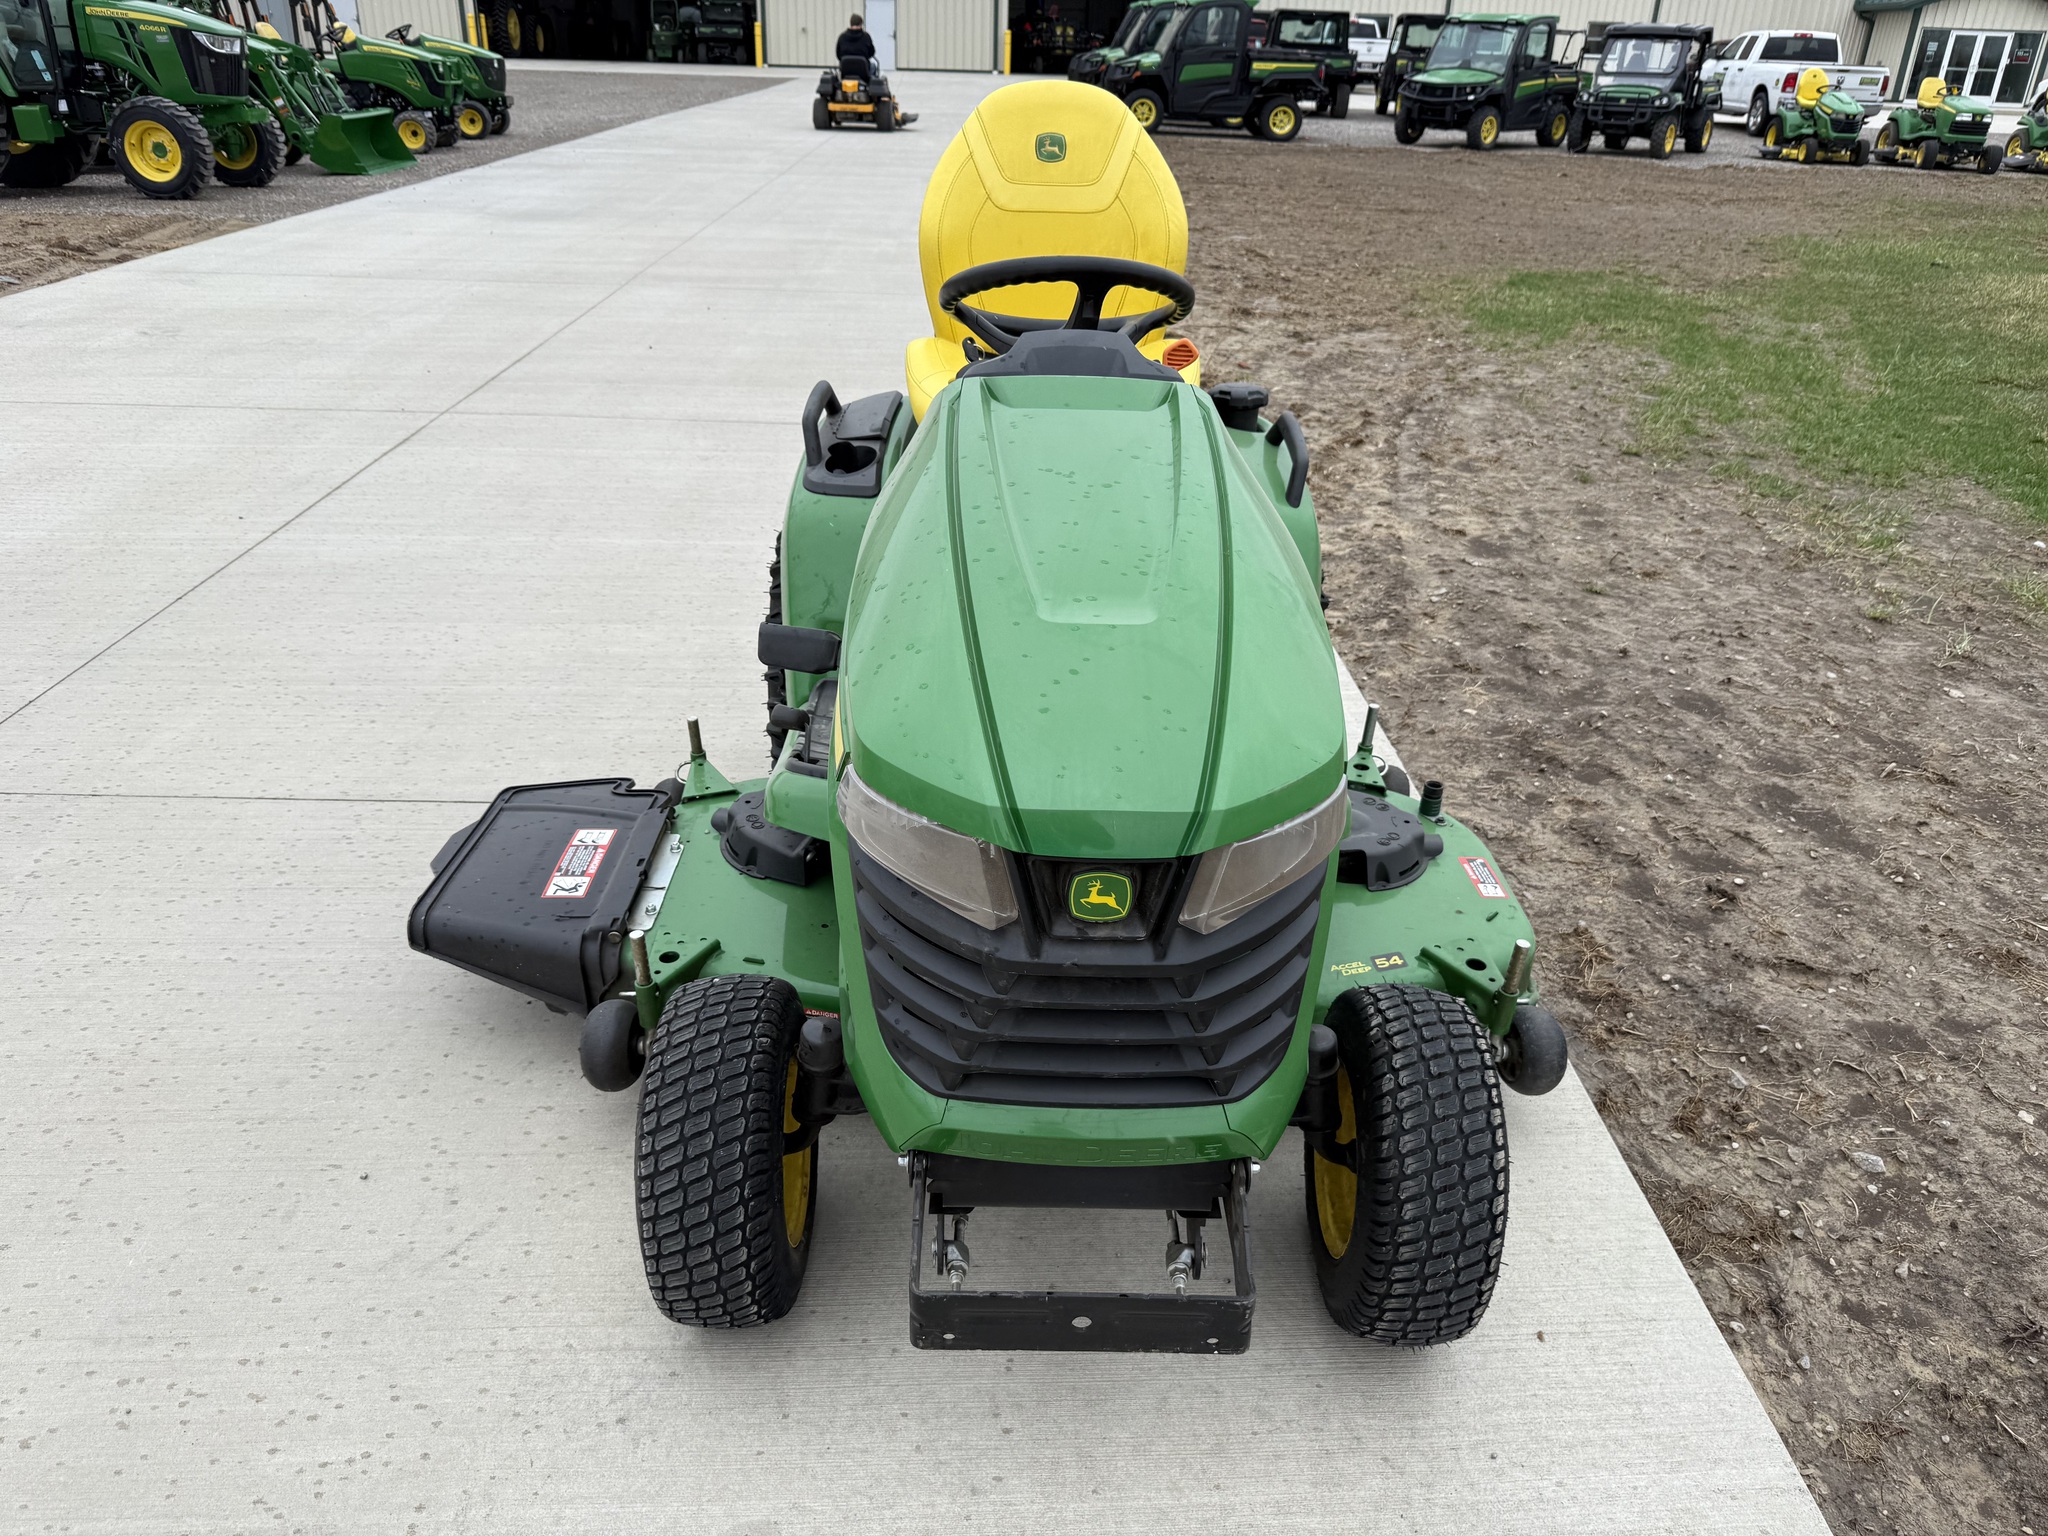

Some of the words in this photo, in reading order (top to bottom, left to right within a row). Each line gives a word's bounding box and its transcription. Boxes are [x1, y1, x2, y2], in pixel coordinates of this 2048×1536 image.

[88, 8, 106, 16] JOHN
[106, 9, 129, 18] DEERE
[139, 24, 167, 32] 4066R
[1330, 961, 1366, 972] ACCEL
[1374, 955, 1404, 968] 54
[1341, 966, 1372, 977] DEEP
[812, 1010, 839, 1018] DANGER
